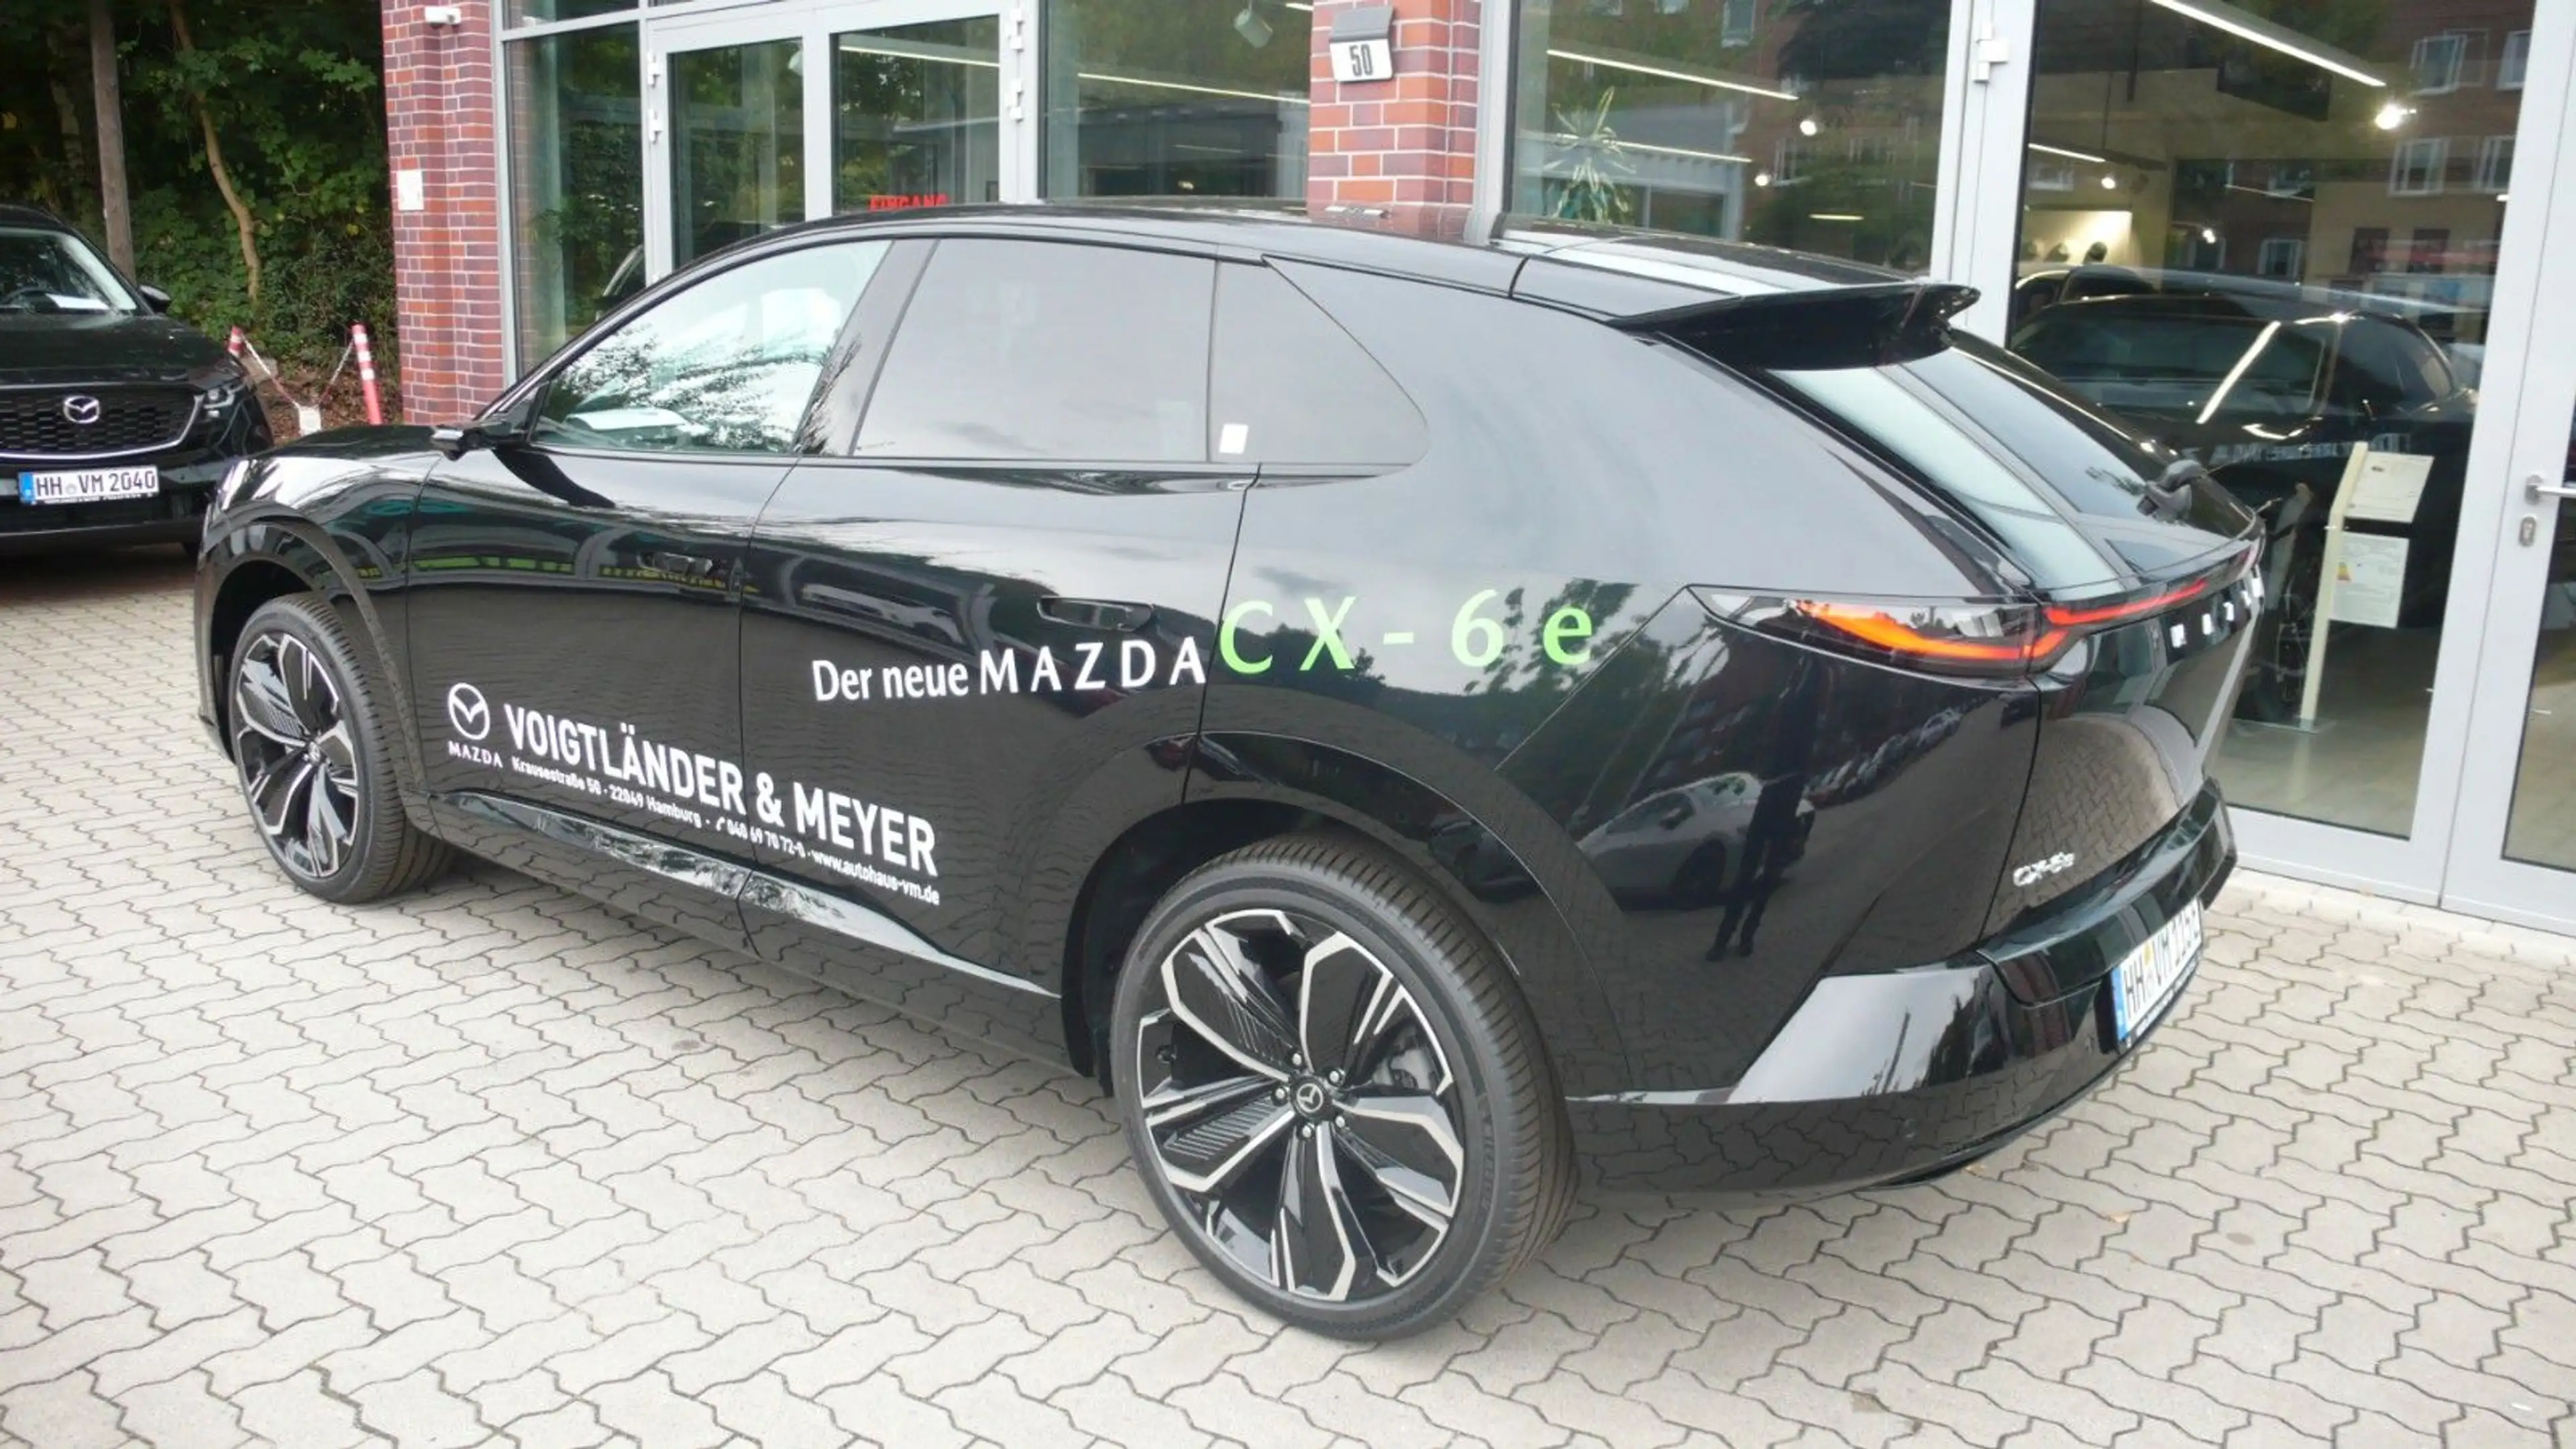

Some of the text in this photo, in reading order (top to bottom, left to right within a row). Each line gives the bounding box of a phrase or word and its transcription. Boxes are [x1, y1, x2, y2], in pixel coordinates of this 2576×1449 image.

[1349, 44, 1374, 77] 50
[36, 470, 156, 496] HH VM 2040
[812, 659, 871, 702] Der
[883, 662, 969, 699] neue
[979, 636, 1207, 695] MAZDA
[447, 740, 503, 769] MAZDA
[504, 702, 938, 877] VOIGTLÄNDER & MEYER
[511, 755, 586, 790] Krausestraße
[586, 776, 602, 796] 50
[646, 794, 702, 829] Hamburg
[810, 849, 941, 906] www.autohaus-vm.de
[2123, 953, 2146, 1019] HH
